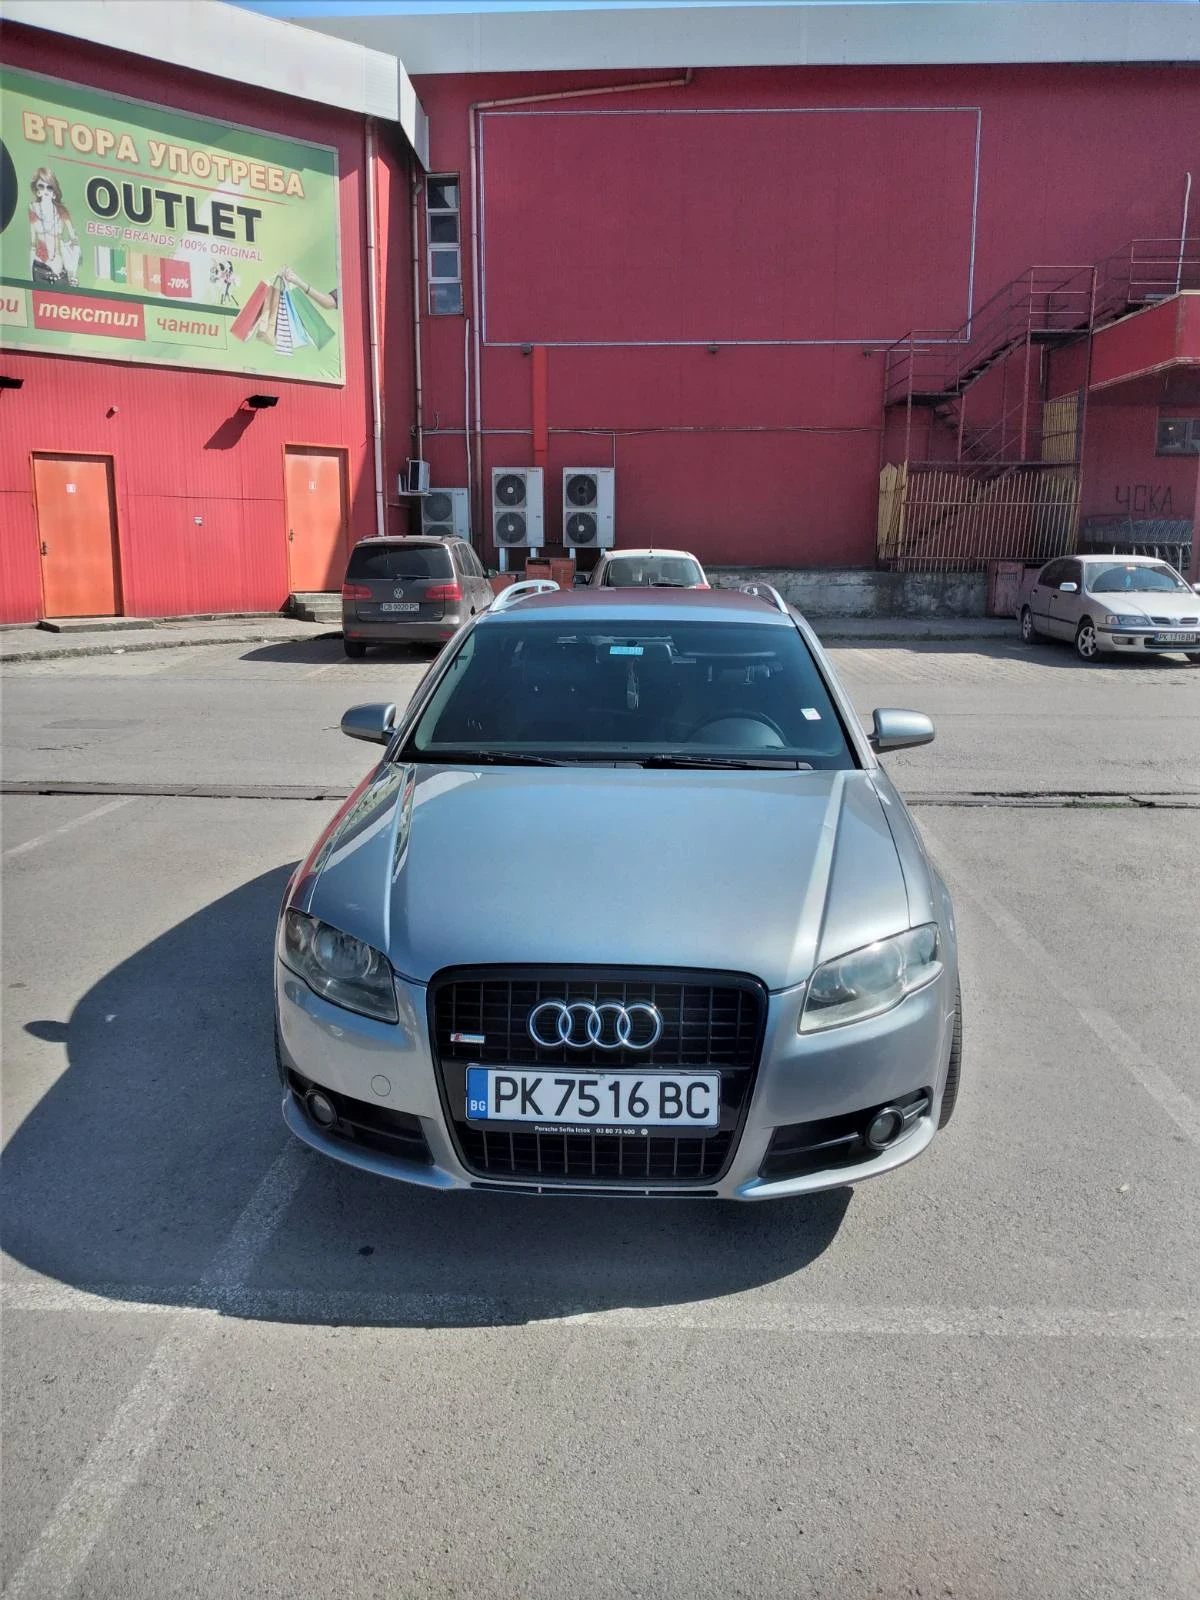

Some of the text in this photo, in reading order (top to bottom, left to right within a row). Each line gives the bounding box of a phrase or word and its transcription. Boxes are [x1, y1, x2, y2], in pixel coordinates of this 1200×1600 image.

[23, 111, 305, 198] ВТОРА УПОТРЕБА
[86, 176, 262, 243] OUTLET
[87, 222, 263, 261] BEST BRANDS 100% ORIGINAL
[167, 277, 190, 289] -70%
[38, 302, 140, 328] текстил
[156, 317, 220, 337] чанти
[470, 1100, 486, 1111] BG
[495, 1076, 711, 1119] PK 7516 BC
